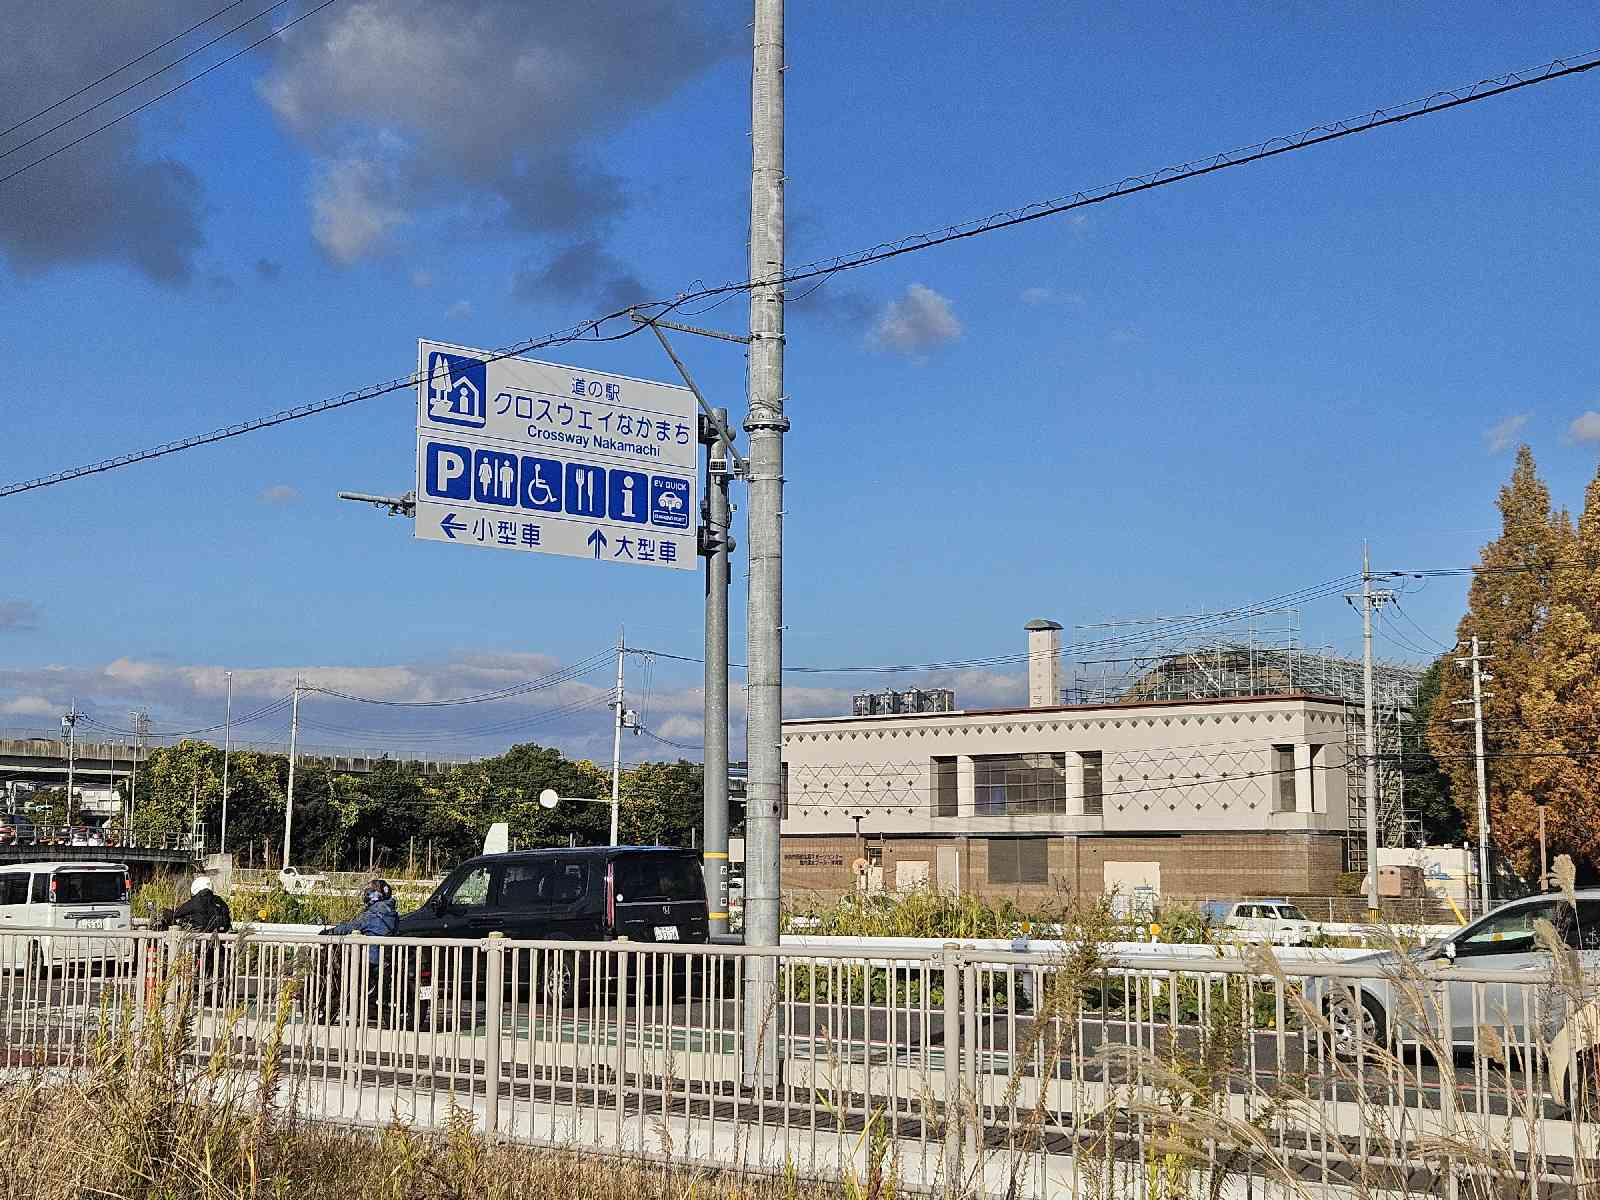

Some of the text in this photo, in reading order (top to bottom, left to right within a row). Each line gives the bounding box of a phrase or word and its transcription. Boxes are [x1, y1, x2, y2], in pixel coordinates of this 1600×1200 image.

[572, 378, 621, 401] 道の駅
[528, 425, 660, 457] Crossway Nakamachi
[437, 450, 464, 491] P
[654, 480, 687, 491] EV QUICK
[472, 518, 541, 547] 小型車
[615, 536, 677, 563] 大型車
